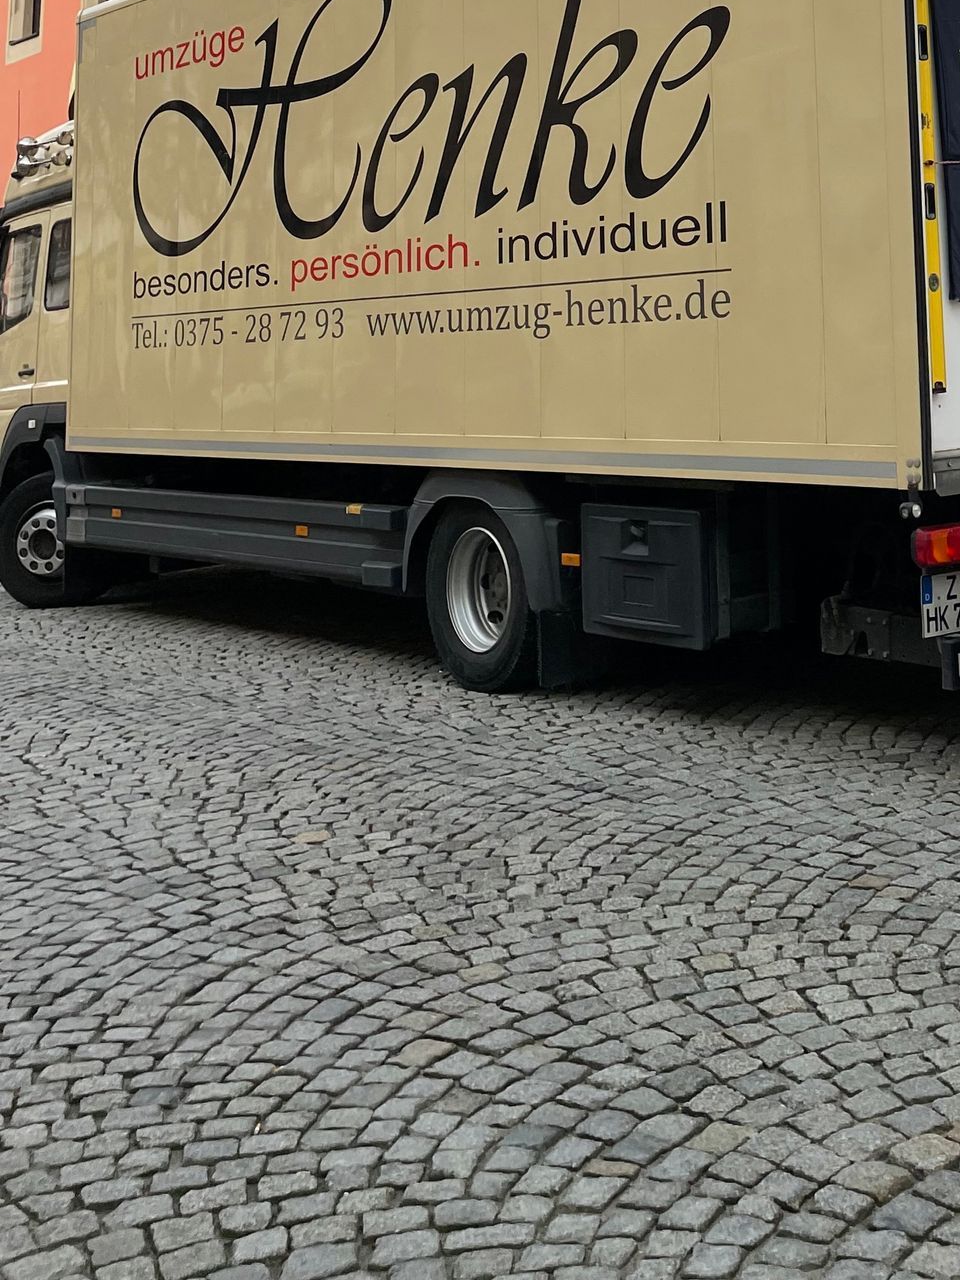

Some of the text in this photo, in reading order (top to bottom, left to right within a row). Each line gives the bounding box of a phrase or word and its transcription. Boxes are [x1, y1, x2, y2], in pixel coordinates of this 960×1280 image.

[134, 24, 246, 81] umzüge
[133, 200, 727, 299] besonders. persönlich. individuell
[131, 320, 168, 349] Tel.:
[174, 316, 224, 347] 0375
[245, 313, 272, 343] 28
[279, 310, 306, 341] 72
[315, 307, 345, 339] 93
[366, 279, 732, 339] www.umzug-henke.de
[946, 575, 957, 600] Z
[926, 605, 949, 633] HK
